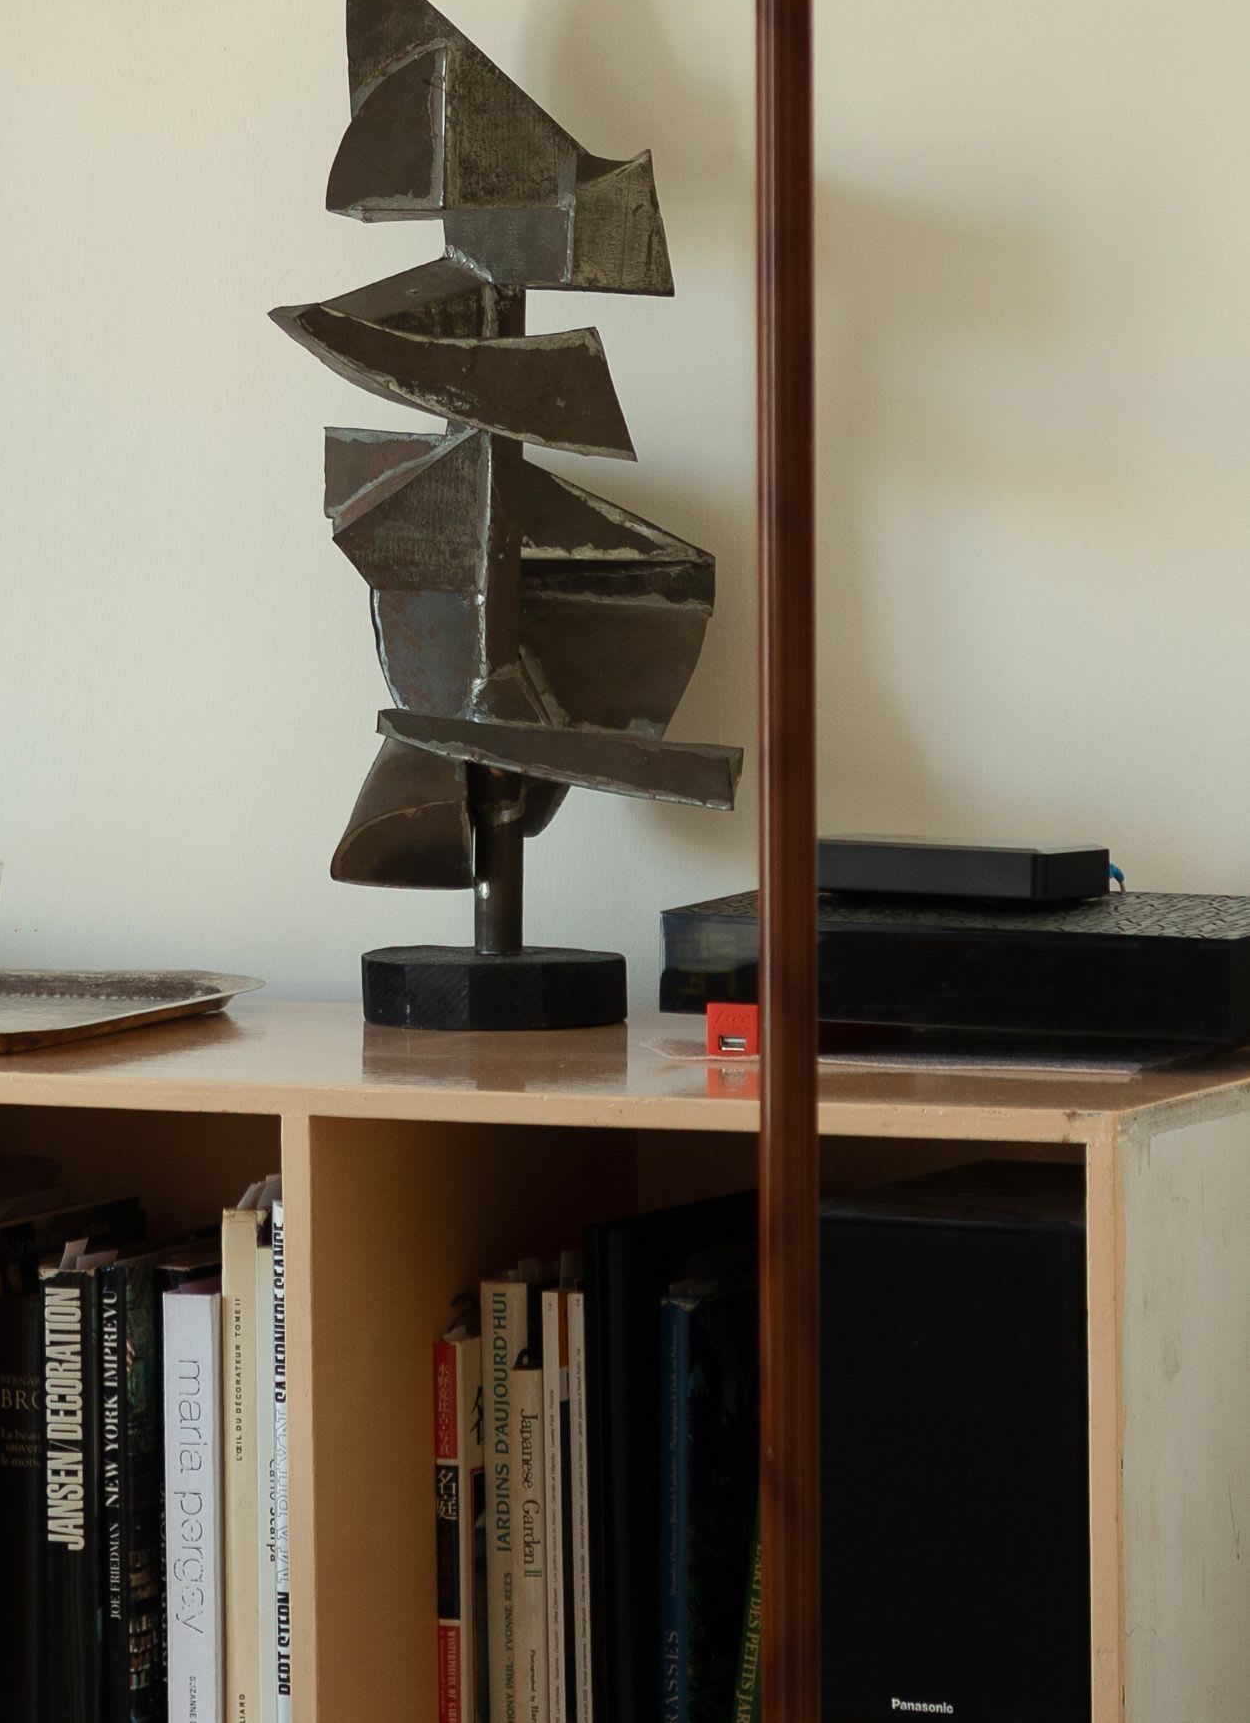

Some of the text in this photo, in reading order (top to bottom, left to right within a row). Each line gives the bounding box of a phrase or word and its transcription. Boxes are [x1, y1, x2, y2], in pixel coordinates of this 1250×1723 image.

[233, 1344, 242, 1414] DÉCORATEUR
[103, 1394, 119, 1452] YORK
[235, 1418, 242, 1431] DU
[492, 1292, 512, 1552] JARDINS D'AUJOURD'HUI
[104, 1460, 120, 1509] NEW
[173, 1359, 208, 1634] maria pergay
[520, 1408, 541, 1563] Japanese Garden
[109, 1522, 121, 1591] FRIEDMAN
[110, 1595, 121, 1620] JOE
[503, 1572, 512, 1600] REES
[504, 1605, 513, 1652] YVONNE
[749, 1597, 762, 1627] DES
[505, 1662, 514, 1689] PAUL
[742, 1631, 760, 1690] PETITS
[891, 1697, 955, 1714] Panasonic
